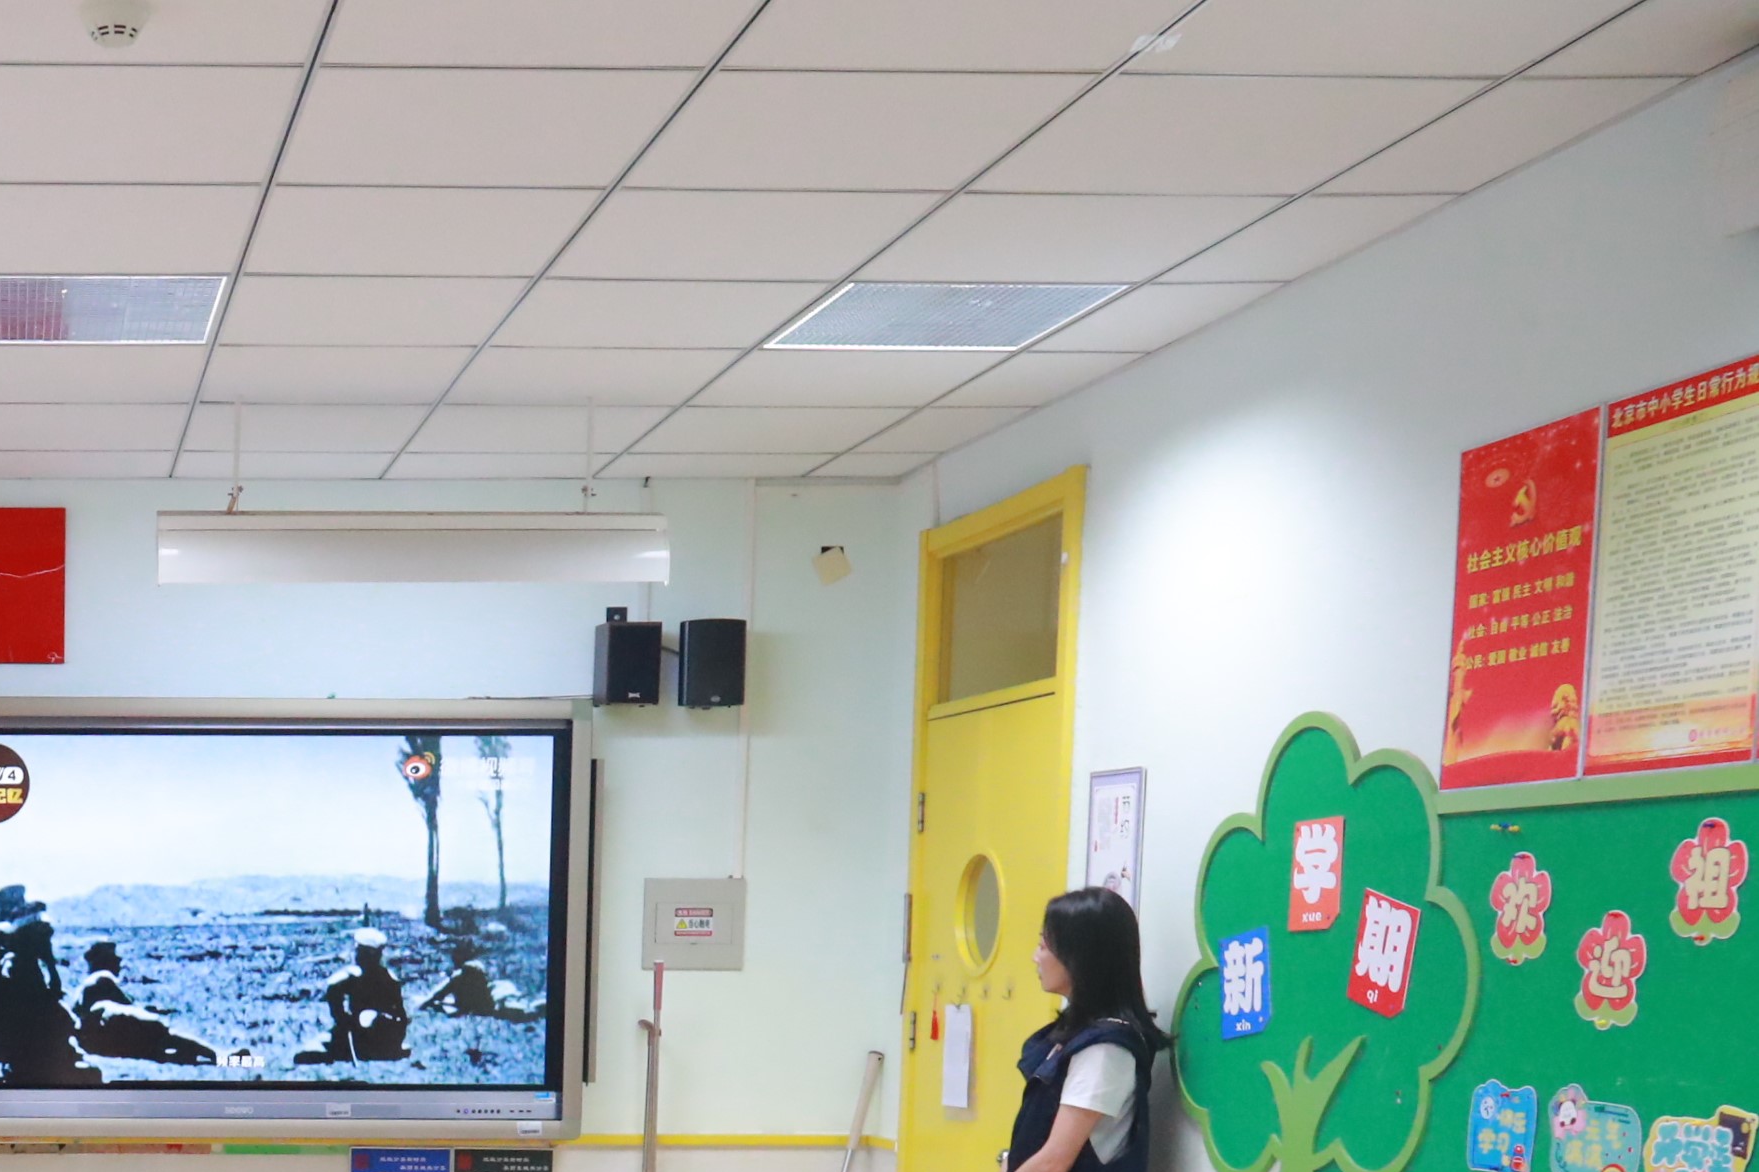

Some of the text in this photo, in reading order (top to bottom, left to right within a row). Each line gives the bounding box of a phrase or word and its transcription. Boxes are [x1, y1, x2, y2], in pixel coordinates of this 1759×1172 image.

[1467, 526, 1582, 573] 社会主义核心价值观
[1294, 824, 1338, 904] 学
[1685, 847, 1730, 909] 祖
[1302, 912, 1322, 922] xue
[1502, 877, 1538, 933] 欢
[1355, 895, 1412, 993] 期
[1589, 936, 1631, 998] 迎
[1223, 937, 1264, 1015] 新
[1367, 989, 1379, 1003] qi
[1235, 1020, 1251, 1031] xin
